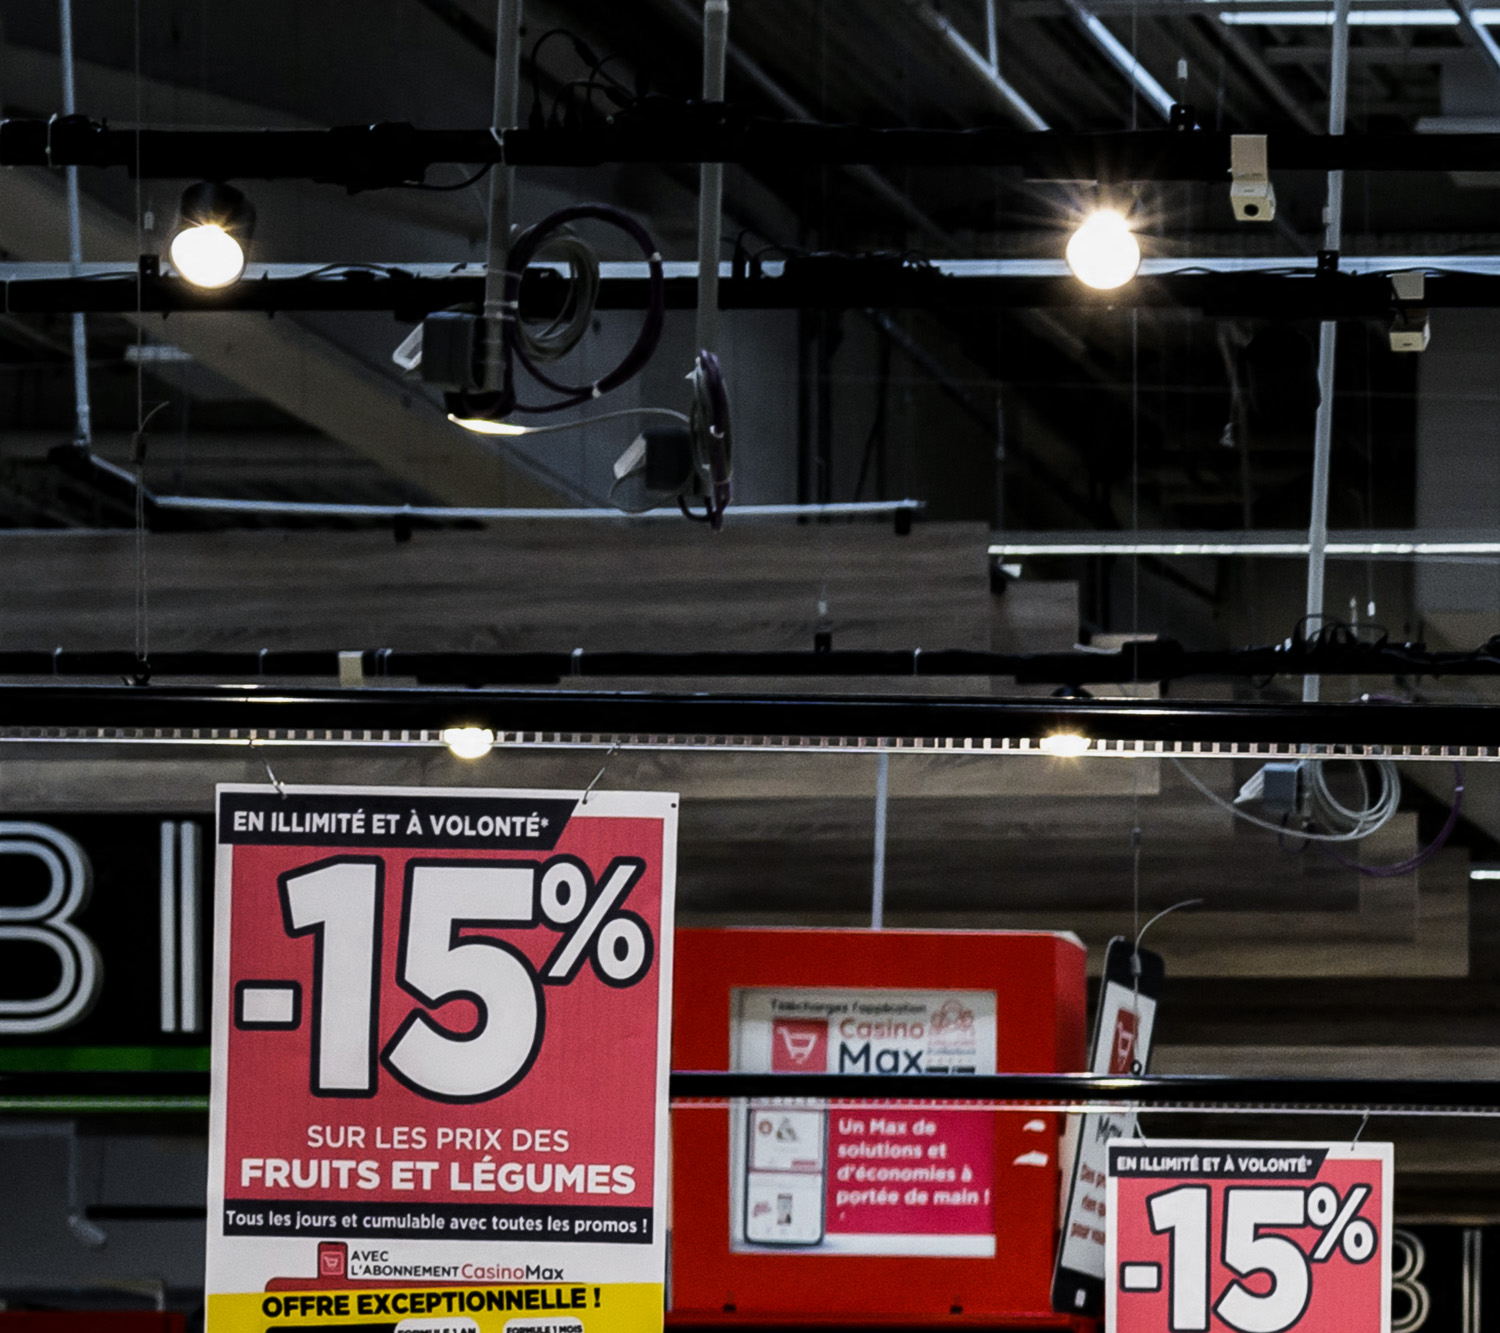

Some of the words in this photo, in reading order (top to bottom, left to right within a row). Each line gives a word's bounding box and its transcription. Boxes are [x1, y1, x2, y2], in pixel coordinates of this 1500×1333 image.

[234, 811, 264, 831] EN
[272, 809, 365, 833] ILLIMITÉ
[372, 814, 400, 834] ET
[406, 810, 422, 834] À
[235, 854, 654, 1104] -15%
[839, 1017, 924, 1039] Casino
[839, 1043, 924, 1074] Max
[308, 1126, 365, 1148] SUR
[376, 1127, 426, 1149] LES
[438, 1128, 502, 1150] PRIX
[513, 1129, 569, 1152] DES
[242, 1158, 380, 1189] FRUITS
[392, 1161, 439, 1190] ET
[451, 1156, 635, 1194] LÉGUMES
[226, 1210, 263, 1225] Tous
[269, 1211, 291, 1226] les
[296, 1212, 336, 1229] jours
[342, 1214, 357, 1227] et
[363, 1214, 444, 1229] cumulable
[450, 1218, 486, 1230] avec
[492, 1216, 542, 1231] toutes
[548, 1216, 570, 1231] les
[575, 1220, 637, 1234] promos
[643, 1219, 647, 1233] !
[351, 1251, 388, 1262] AVEC
[352, 1265, 459, 1277] L'ABONNEMENT
[462, 1264, 563, 1280] CasinoMax
[262, 1295, 350, 1318] OFFRE
[357, 1288, 586, 1314] EXCEPTIONNELLE
[594, 1288, 600, 1308] !
[553, 1326, 556, 1333] 1
[559, 1325, 582, 1333] MOIS
